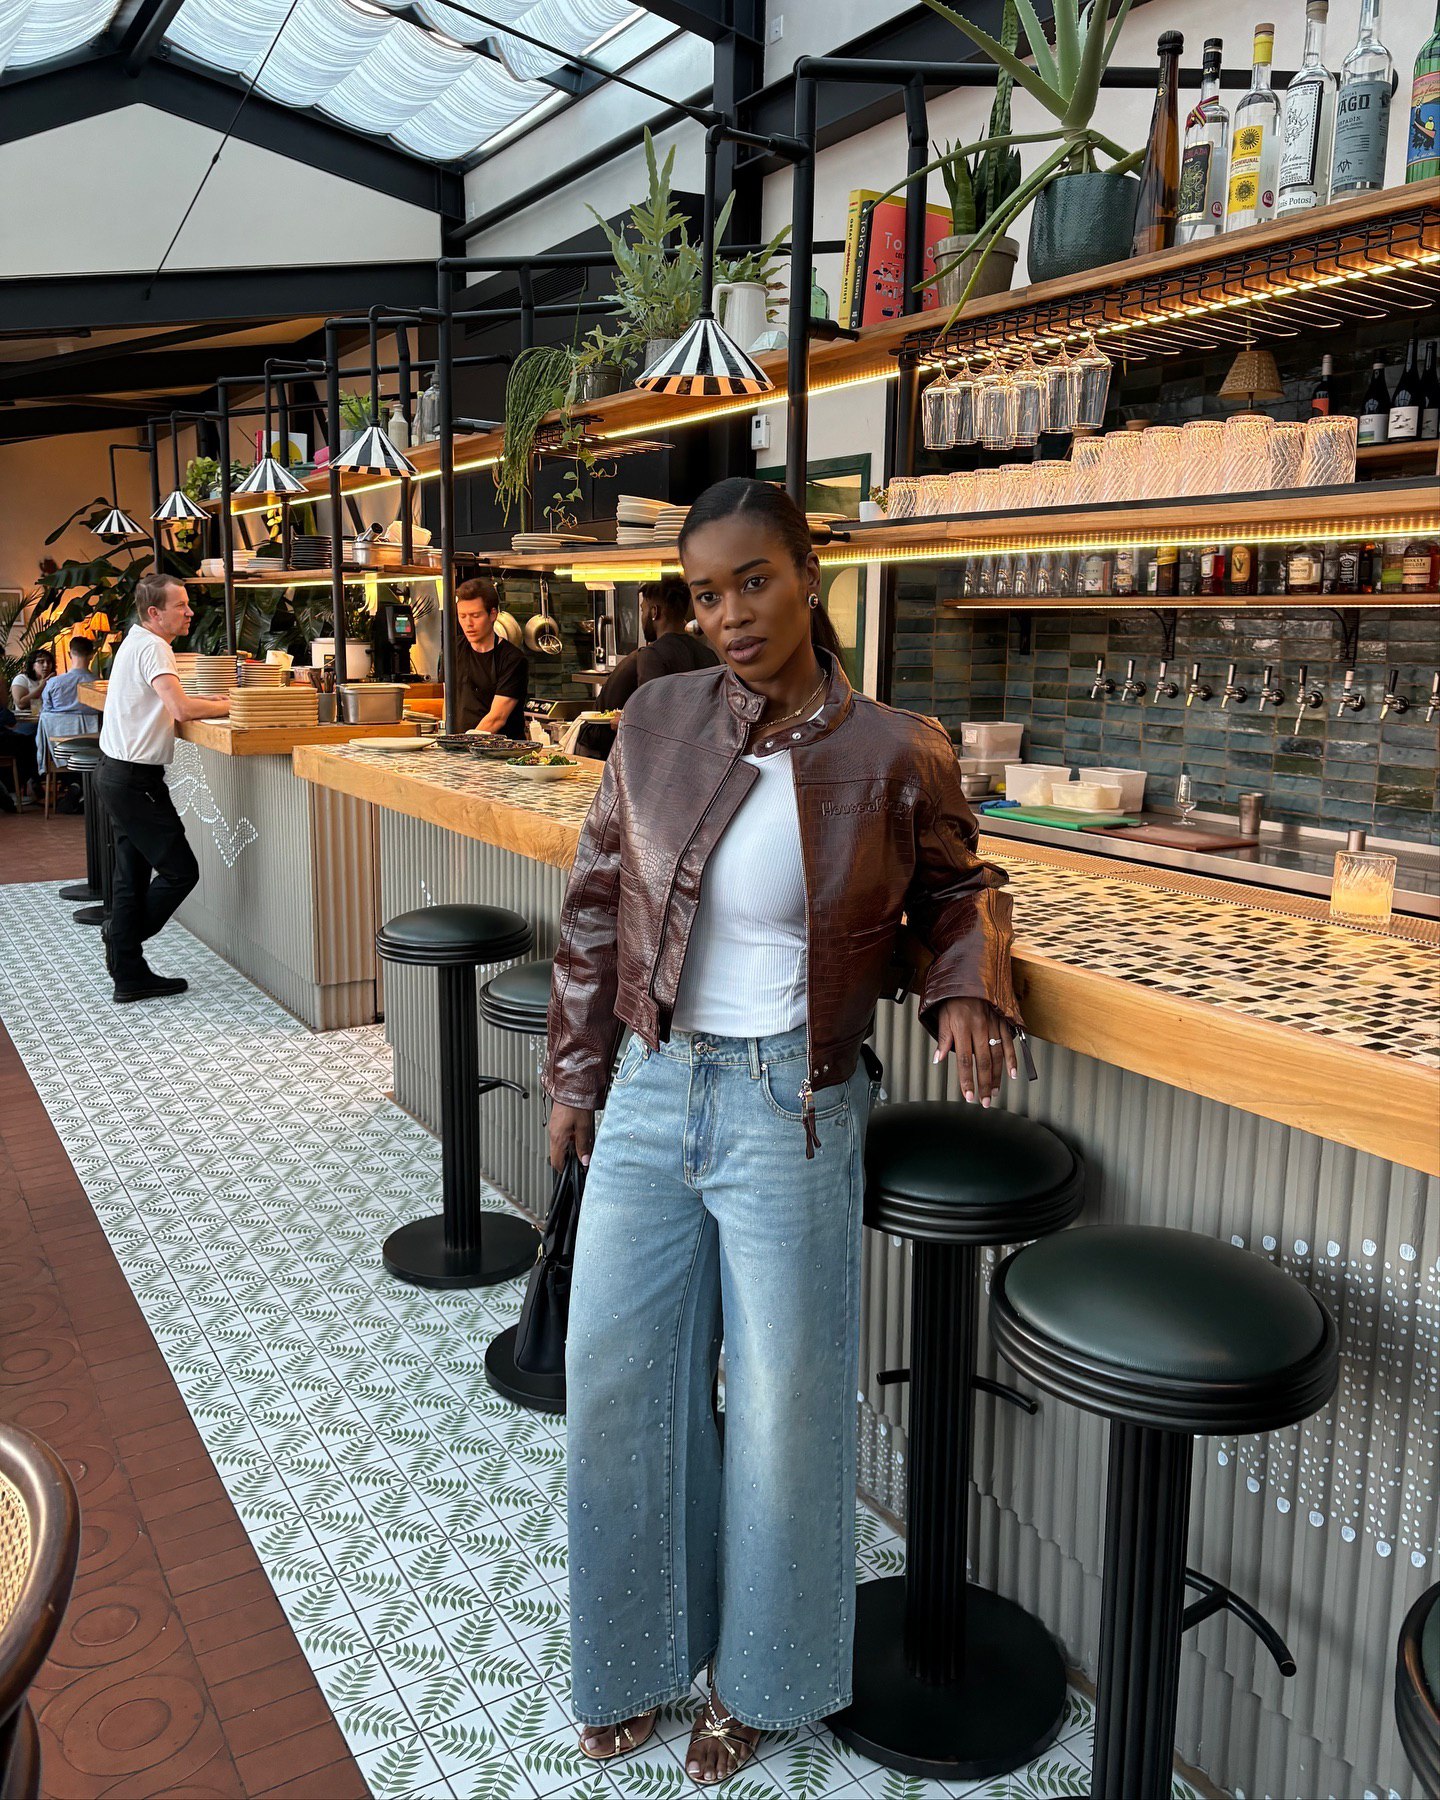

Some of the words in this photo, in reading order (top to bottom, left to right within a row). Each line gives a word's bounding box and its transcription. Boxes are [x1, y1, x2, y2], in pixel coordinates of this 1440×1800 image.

[858, 219, 867, 257] TOKYO
[821, 800, 864, 816] House
[867, 796, 882, 812] of
